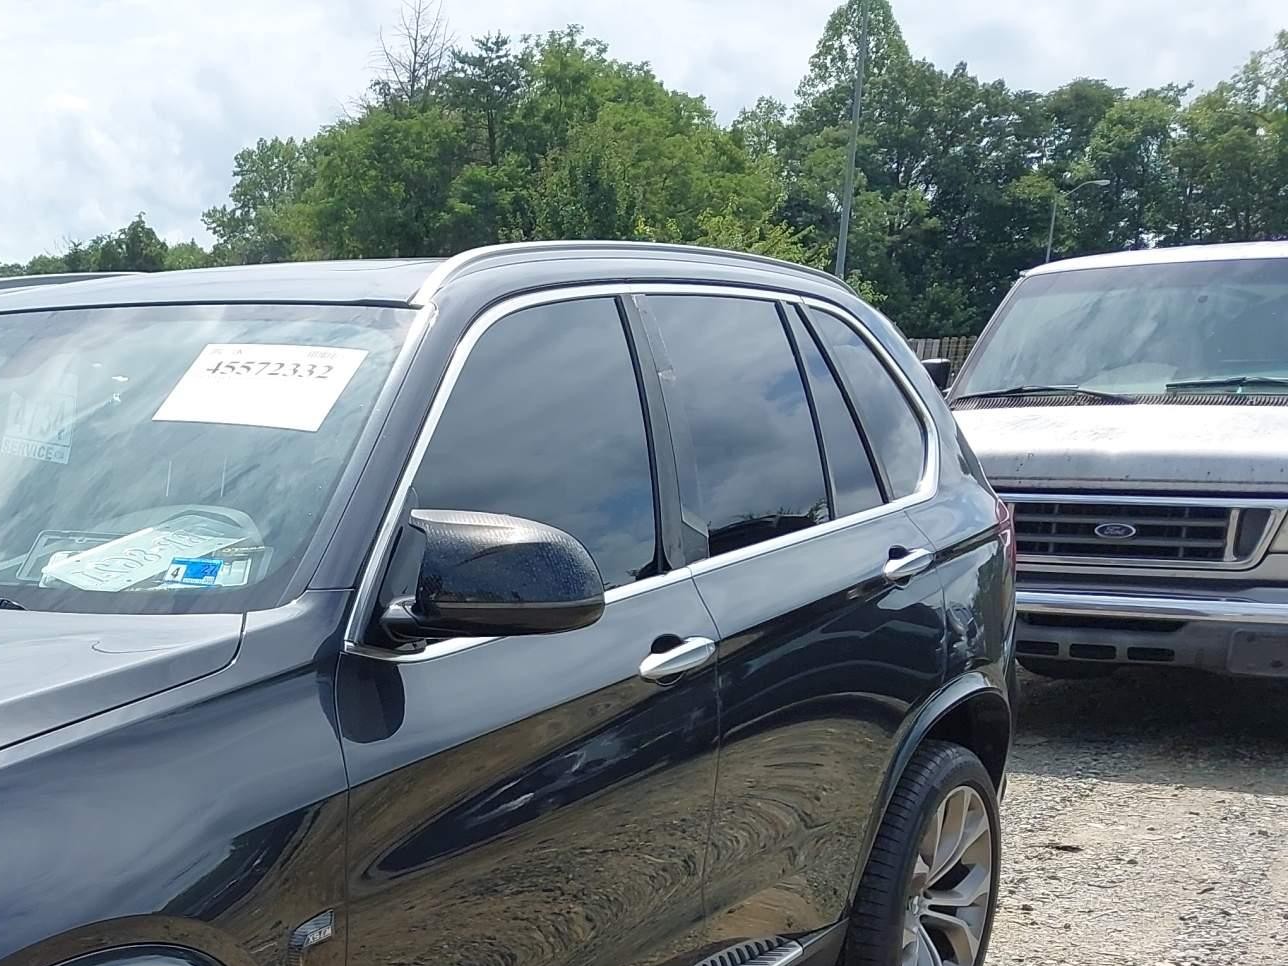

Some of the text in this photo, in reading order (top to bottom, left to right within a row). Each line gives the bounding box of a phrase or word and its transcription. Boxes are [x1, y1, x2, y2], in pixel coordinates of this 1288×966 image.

[205, 360, 334, 379] 45572332
[1, 438, 54, 461] SERVICE
[171, 566, 182, 579] 4
